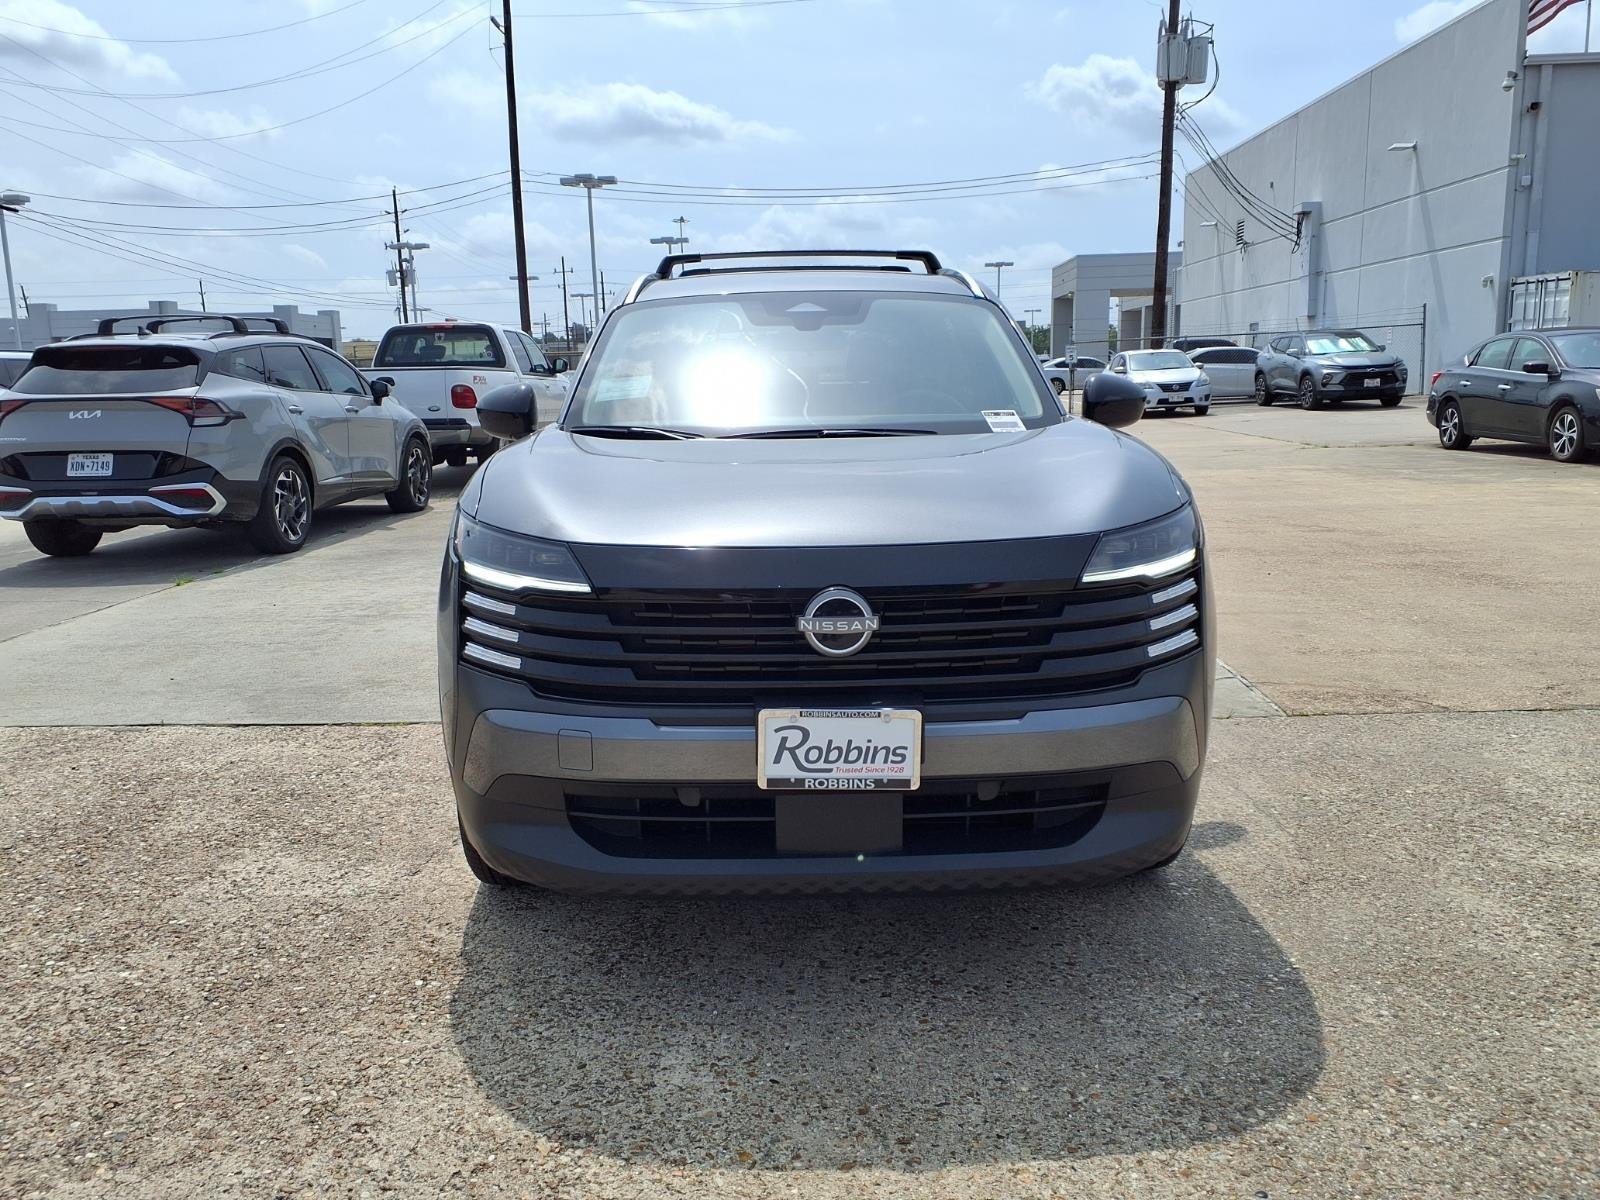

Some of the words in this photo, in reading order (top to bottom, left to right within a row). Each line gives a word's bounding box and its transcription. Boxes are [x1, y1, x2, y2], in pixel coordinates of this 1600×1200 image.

[69, 409, 102, 419] KIA
[800, 619, 877, 631] NISSAN
[772, 725, 908, 773] Robbins
[836, 766, 863, 774] Trusted
[865, 766, 886, 774] Since
[804, 778, 876, 789] ROBBINS
